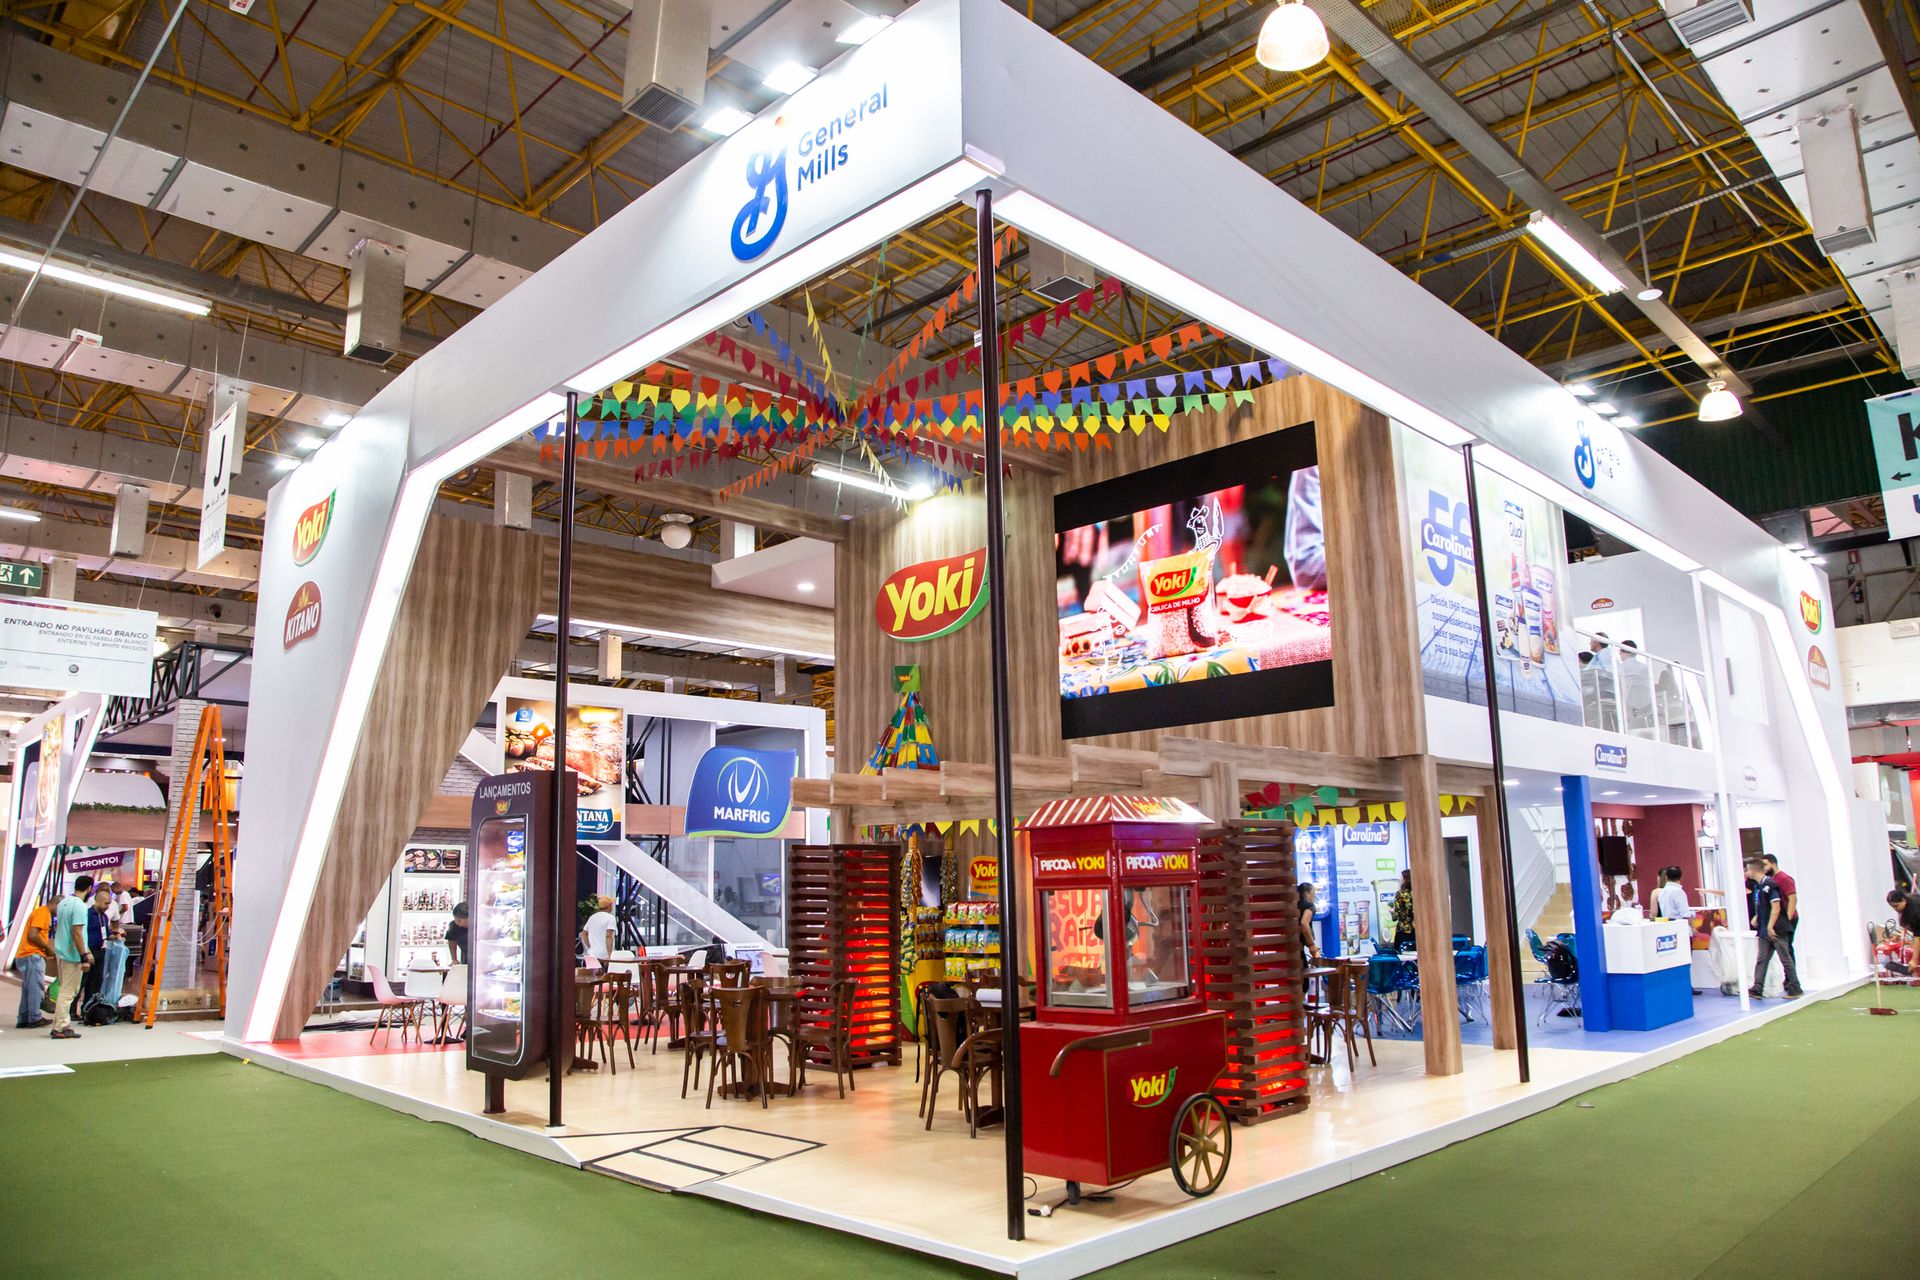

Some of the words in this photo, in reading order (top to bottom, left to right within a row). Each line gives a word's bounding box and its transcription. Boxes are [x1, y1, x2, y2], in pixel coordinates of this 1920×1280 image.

[798, 81, 888, 157] General
[797, 144, 849, 191] Mills
[296, 503, 327, 556] Yoki
[1154, 571, 1187, 595] Yoki
[885, 557, 976, 633] Yoki
[4, 617, 53, 629] ENTRANDO
[71, 625, 113, 636] PAVILHÃO
[114, 630, 149, 640] BRANCO
[285, 602, 320, 643] KITANO
[479, 781, 531, 801] LANÇAMENTOS
[577, 810, 609, 822] NTANA
[713, 806, 771, 824] MARFRIG
[1344, 825, 1383, 842] Carolina
[79, 856, 119, 868] PRONTO!
[973, 863, 998, 879] Yoki
[1040, 858, 1072, 872] PIPOCA
[1076, 855, 1105, 871] YOKI
[1125, 855, 1158, 870] PIPOCA
[1162, 854, 1188, 870] YOKI
[1131, 1074, 1165, 1102] Yoki
